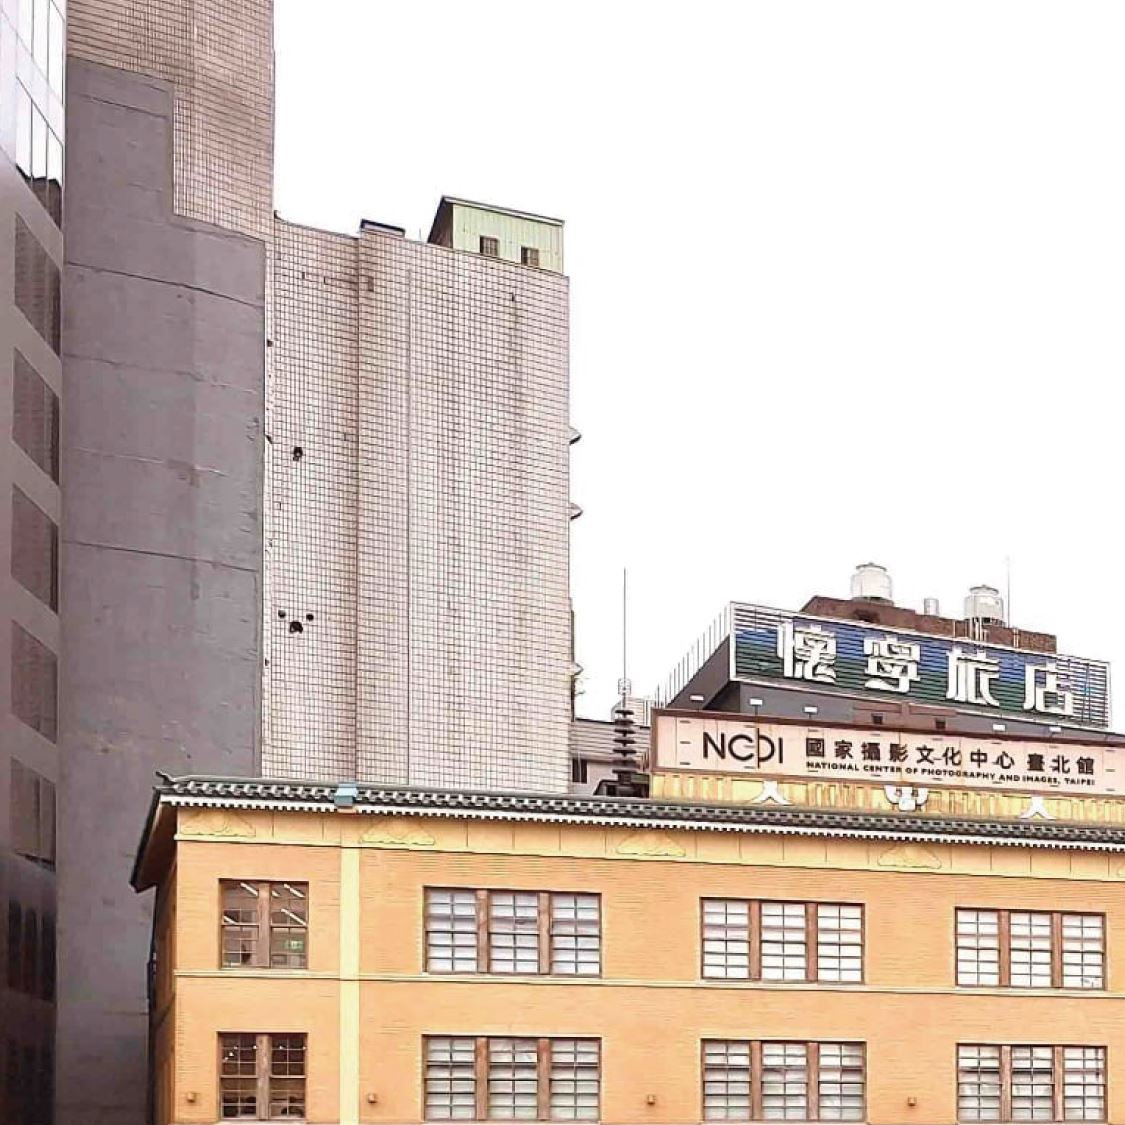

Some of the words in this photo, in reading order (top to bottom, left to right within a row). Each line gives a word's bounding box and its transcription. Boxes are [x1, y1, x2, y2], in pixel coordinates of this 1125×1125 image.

[806, 761, 860, 771] NATIONAL
[863, 764, 901, 774] CENTER
[905, 767, 919, 775] OF
[921, 768, 996, 780] PHOTOGRAPHY
[999, 774, 1020, 782] AND
[1064, 778, 1096, 786] TAIPEI
